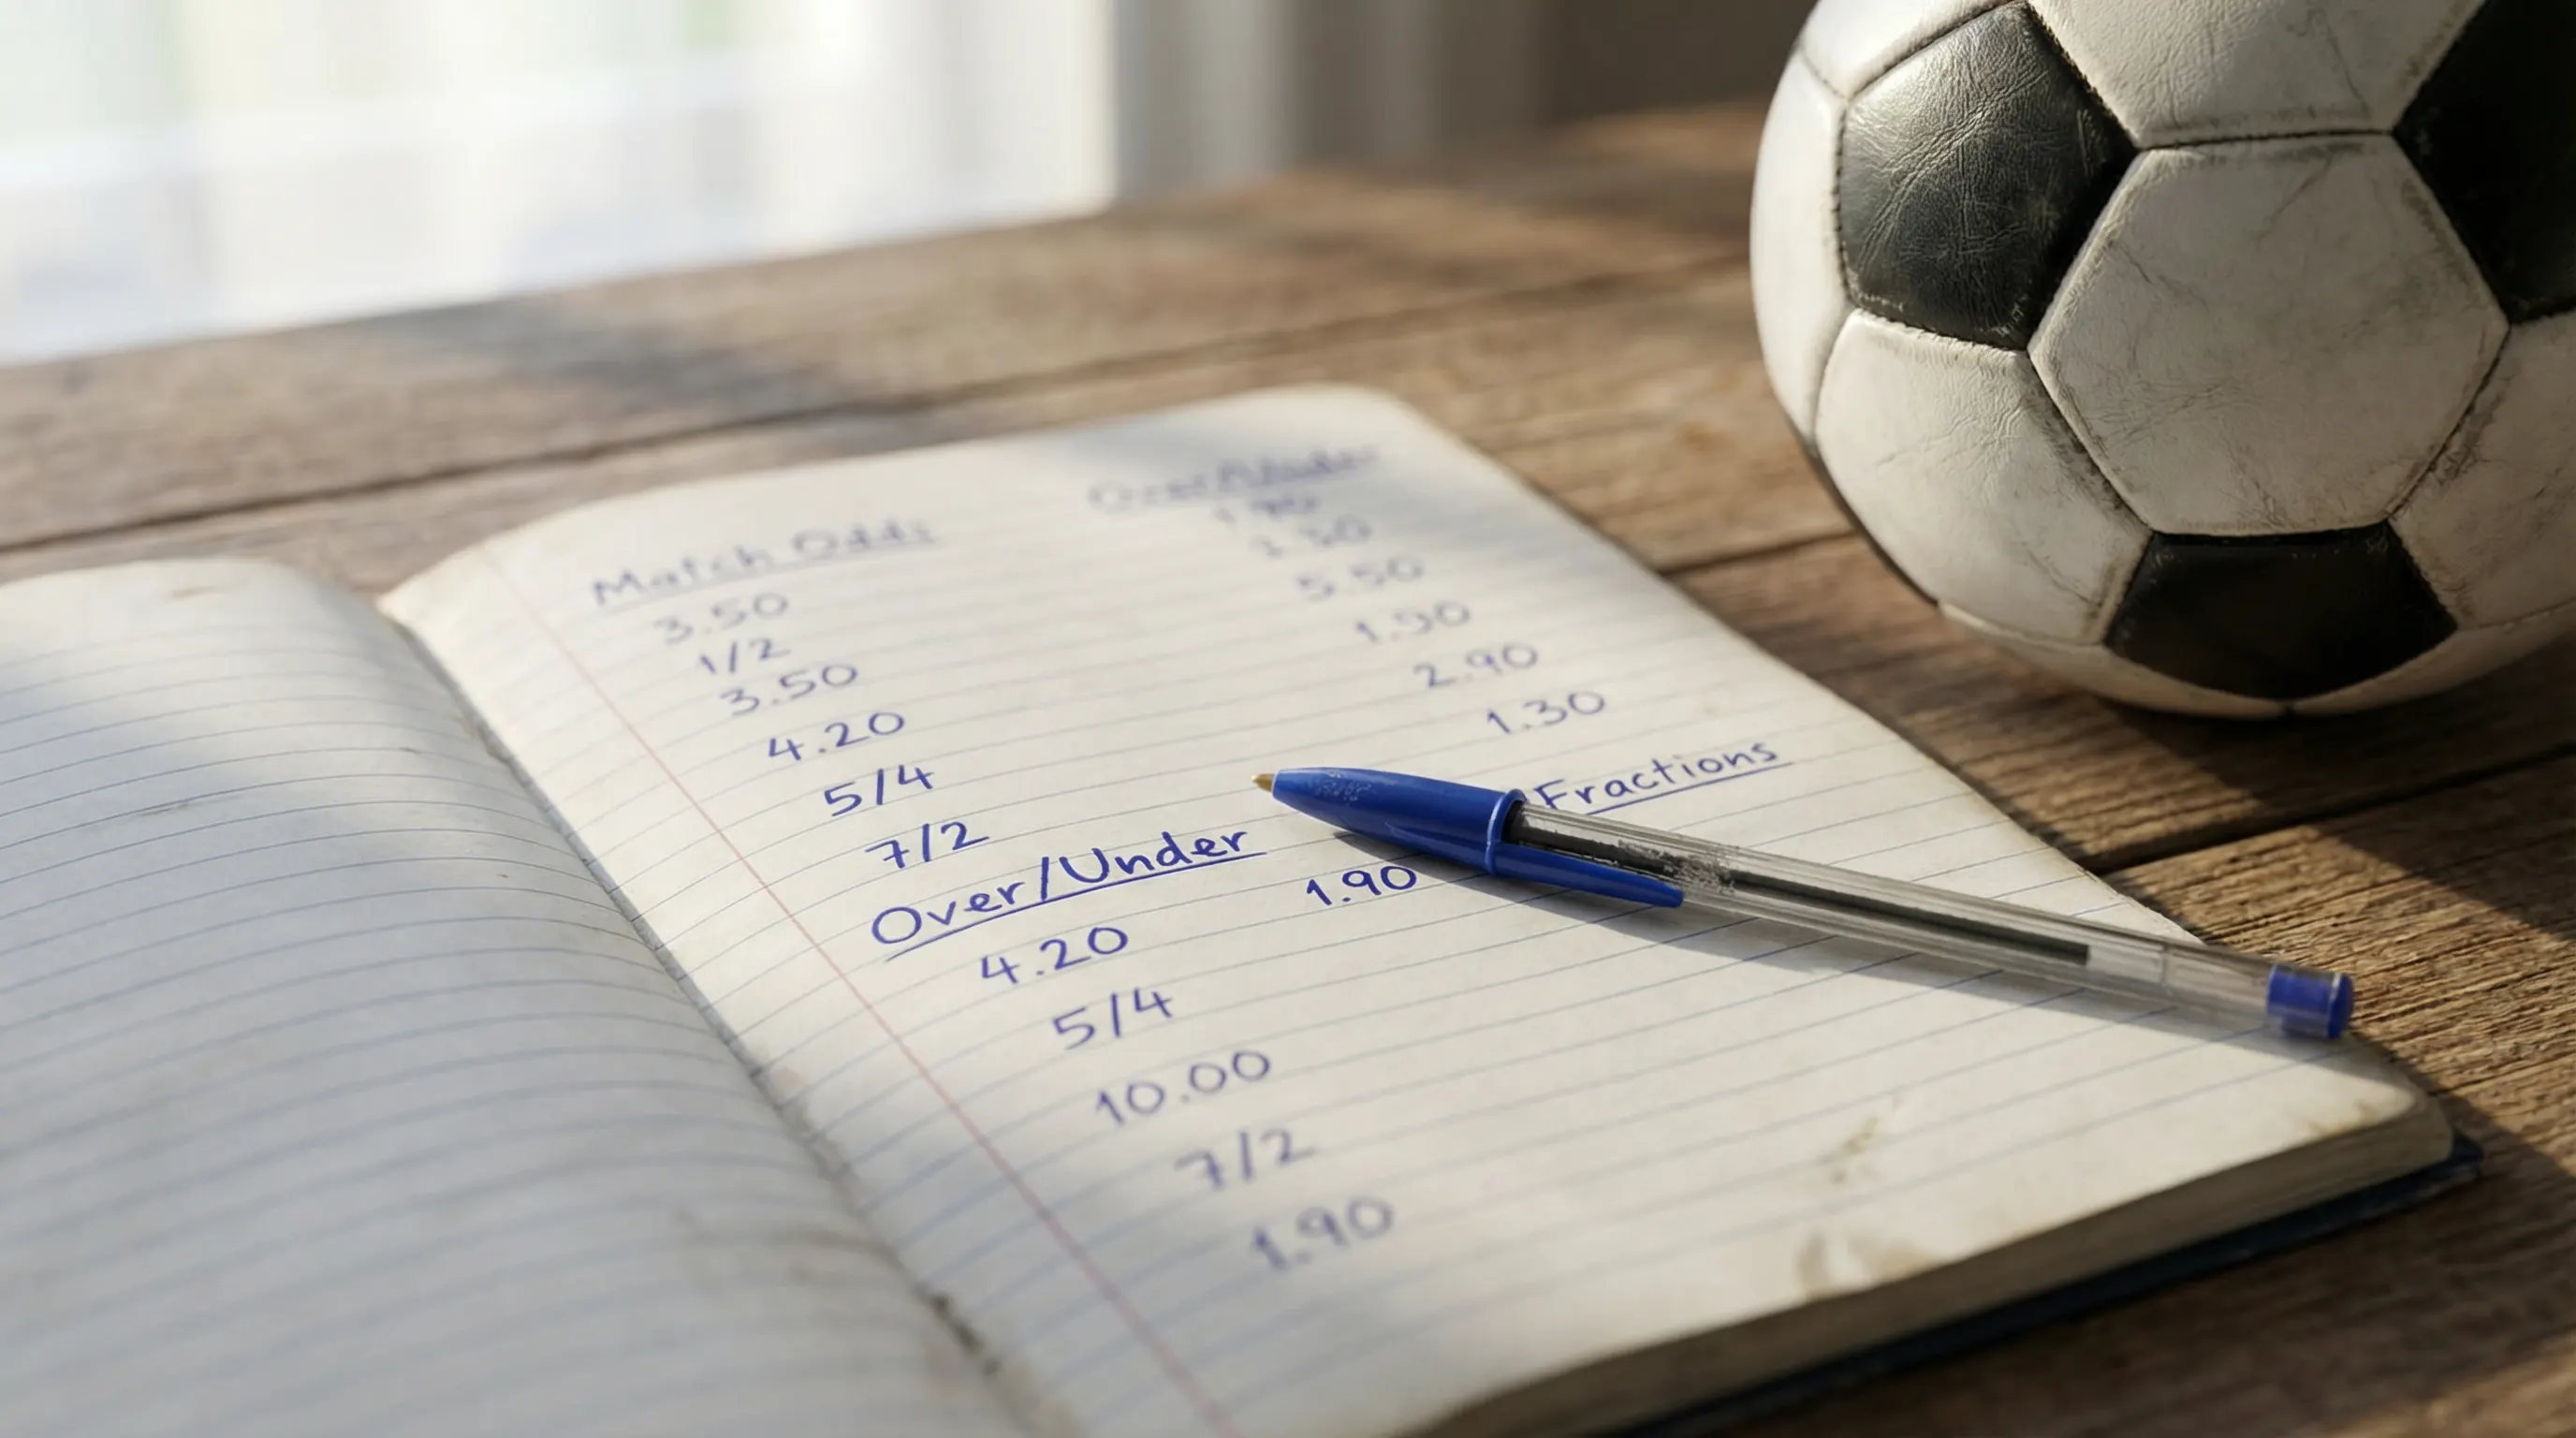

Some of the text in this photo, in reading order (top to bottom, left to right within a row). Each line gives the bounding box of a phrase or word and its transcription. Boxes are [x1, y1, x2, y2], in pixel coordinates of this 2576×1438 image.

[593, 521, 937, 606] Match Odds
[654, 592, 789, 645] 3.50
[700, 638, 791, 674] 1/2
[1413, 642, 1539, 689] 2.90
[719, 664, 858, 716] 3.50
[1486, 690, 1605, 736] 1.30
[768, 712, 905, 761] 4.20
[824, 765, 933, 817] 5/4
[1533, 742, 1778, 810] Fractions
[865, 821, 989, 869] 7/2
[871, 830, 1248, 945] Over/Under
[1306, 864, 1418, 908] 1.90
[980, 926, 1129, 984] 4.20
[1051, 987, 1174, 1049] 5/4
[1094, 1049, 1271, 1126] 10.00
[1174, 1127, 1317, 1190] 7/2
[1250, 1196, 1394, 1270] 1.90
